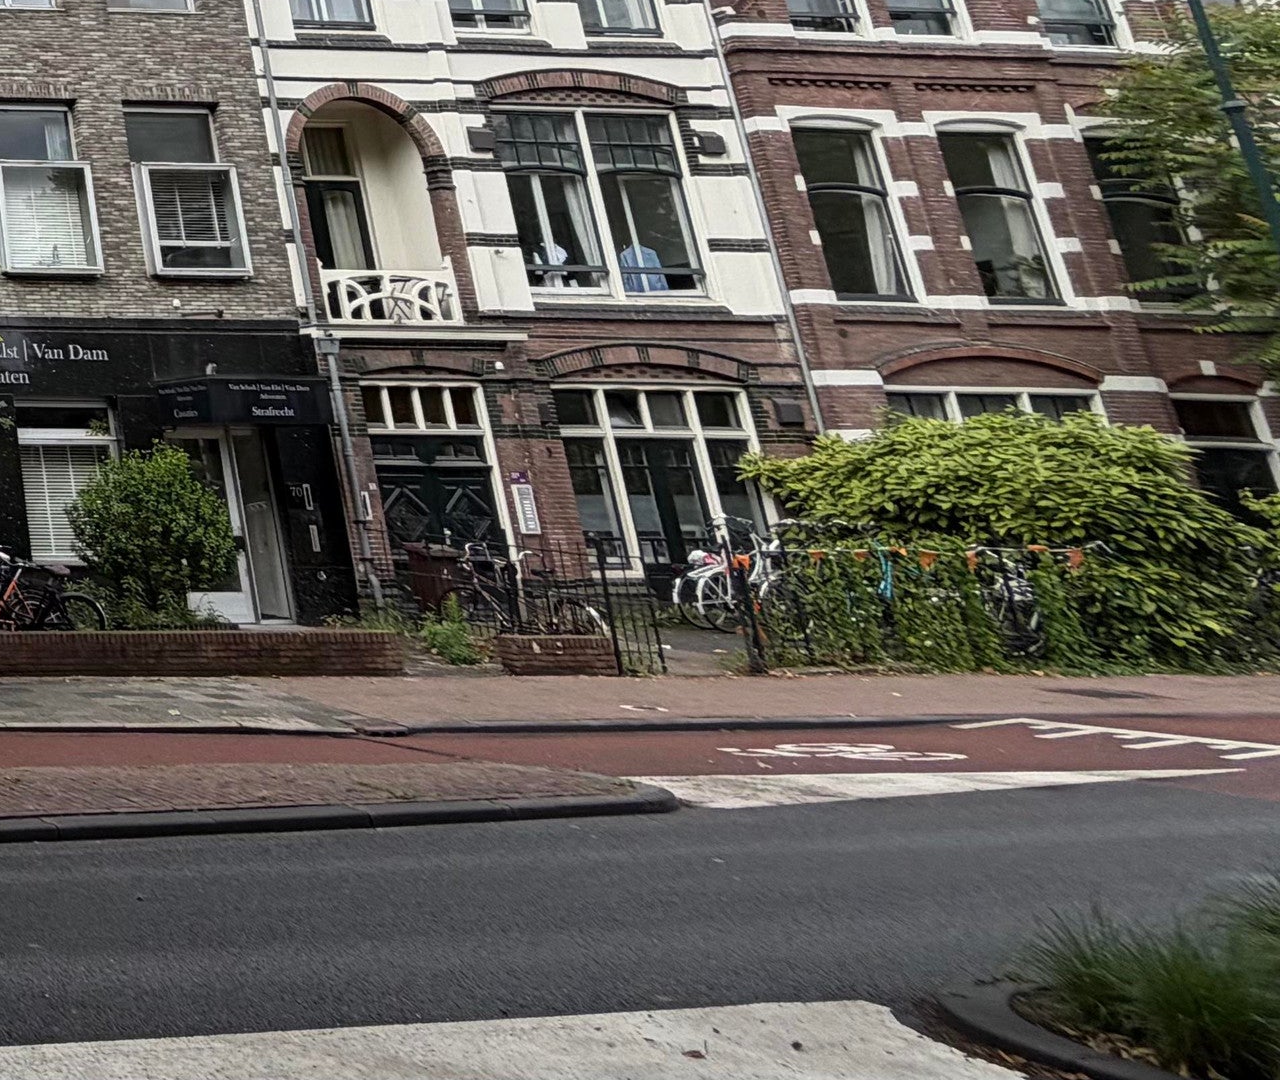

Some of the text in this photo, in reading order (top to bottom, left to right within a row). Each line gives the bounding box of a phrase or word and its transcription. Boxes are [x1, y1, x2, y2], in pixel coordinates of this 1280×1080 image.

[32, 343, 65, 360] Van
[68, 344, 110, 361] Dam
[252, 406, 294, 417] Strafrecht
[290, 486, 303, 497] 70
